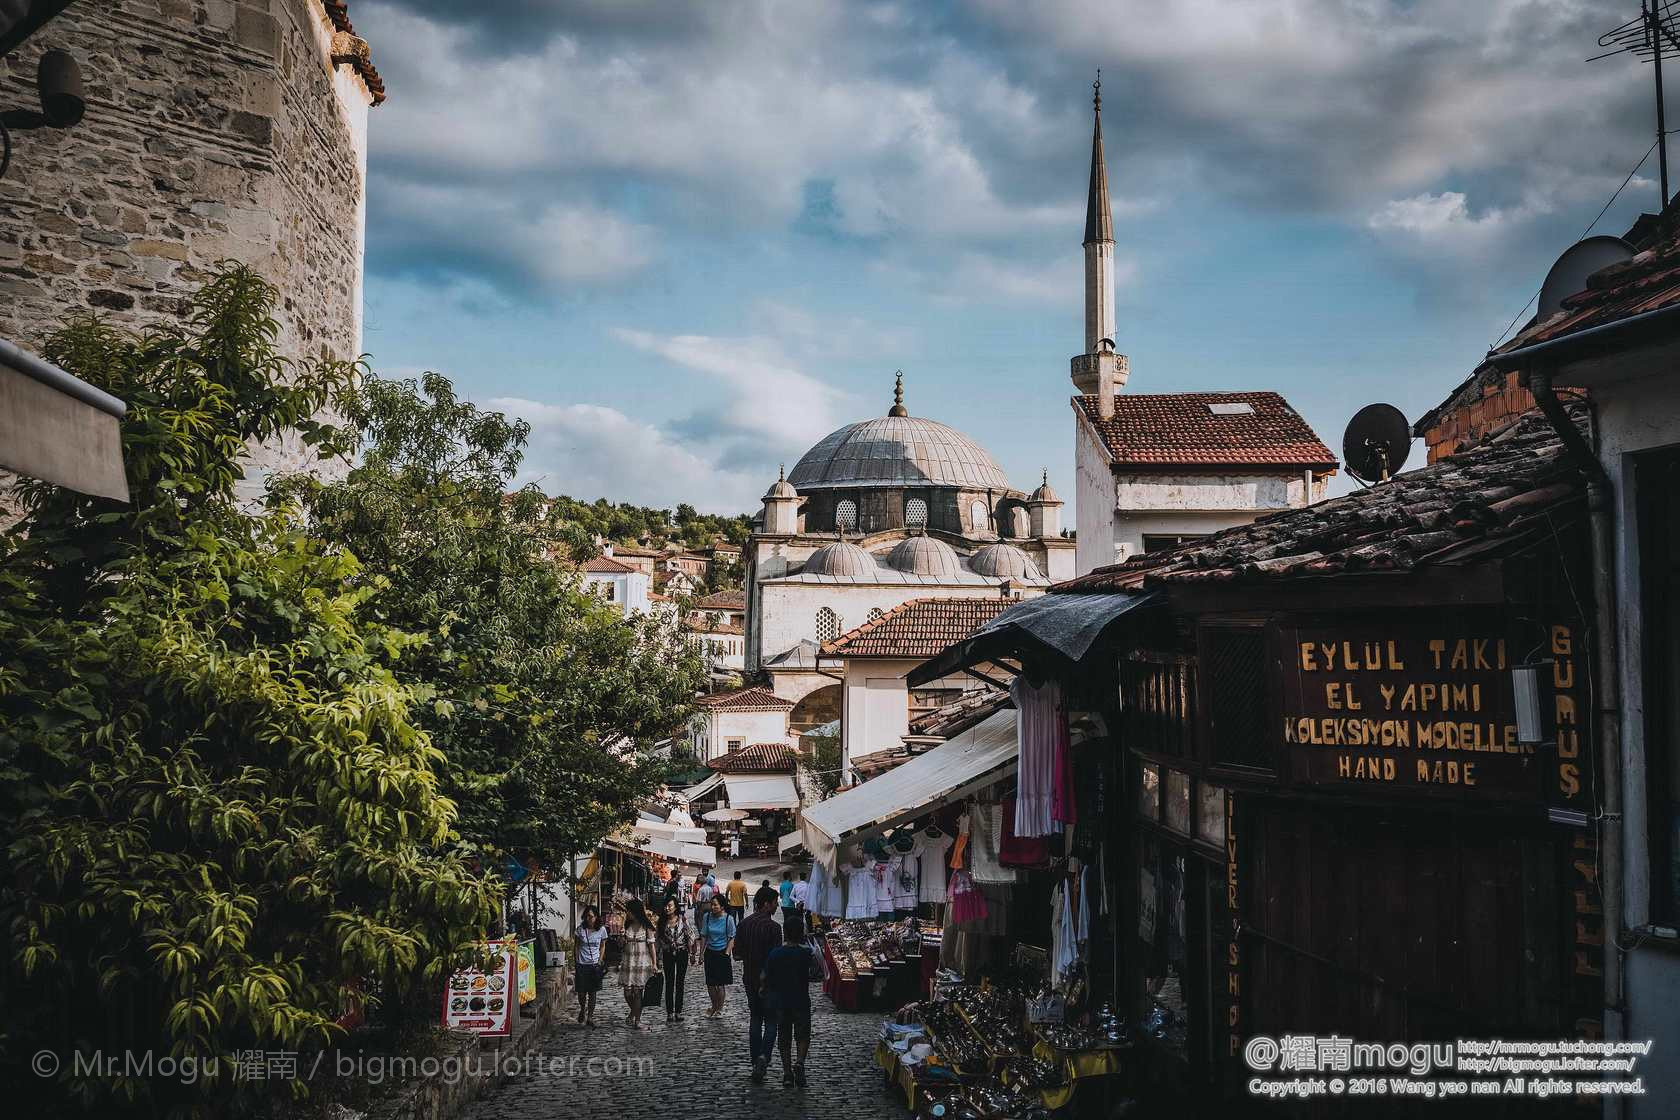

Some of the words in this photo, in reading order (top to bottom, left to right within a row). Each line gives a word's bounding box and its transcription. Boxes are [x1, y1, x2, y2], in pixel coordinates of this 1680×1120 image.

[1428, 639, 1506, 670] TAKI
[1326, 682, 1362, 710] EL
[1380, 683, 1481, 711] YAPIMI
[1416, 721, 1537, 754] MODELLE
[1339, 756, 1396, 780] HAND
[1417, 759, 1477, 785] MADE
